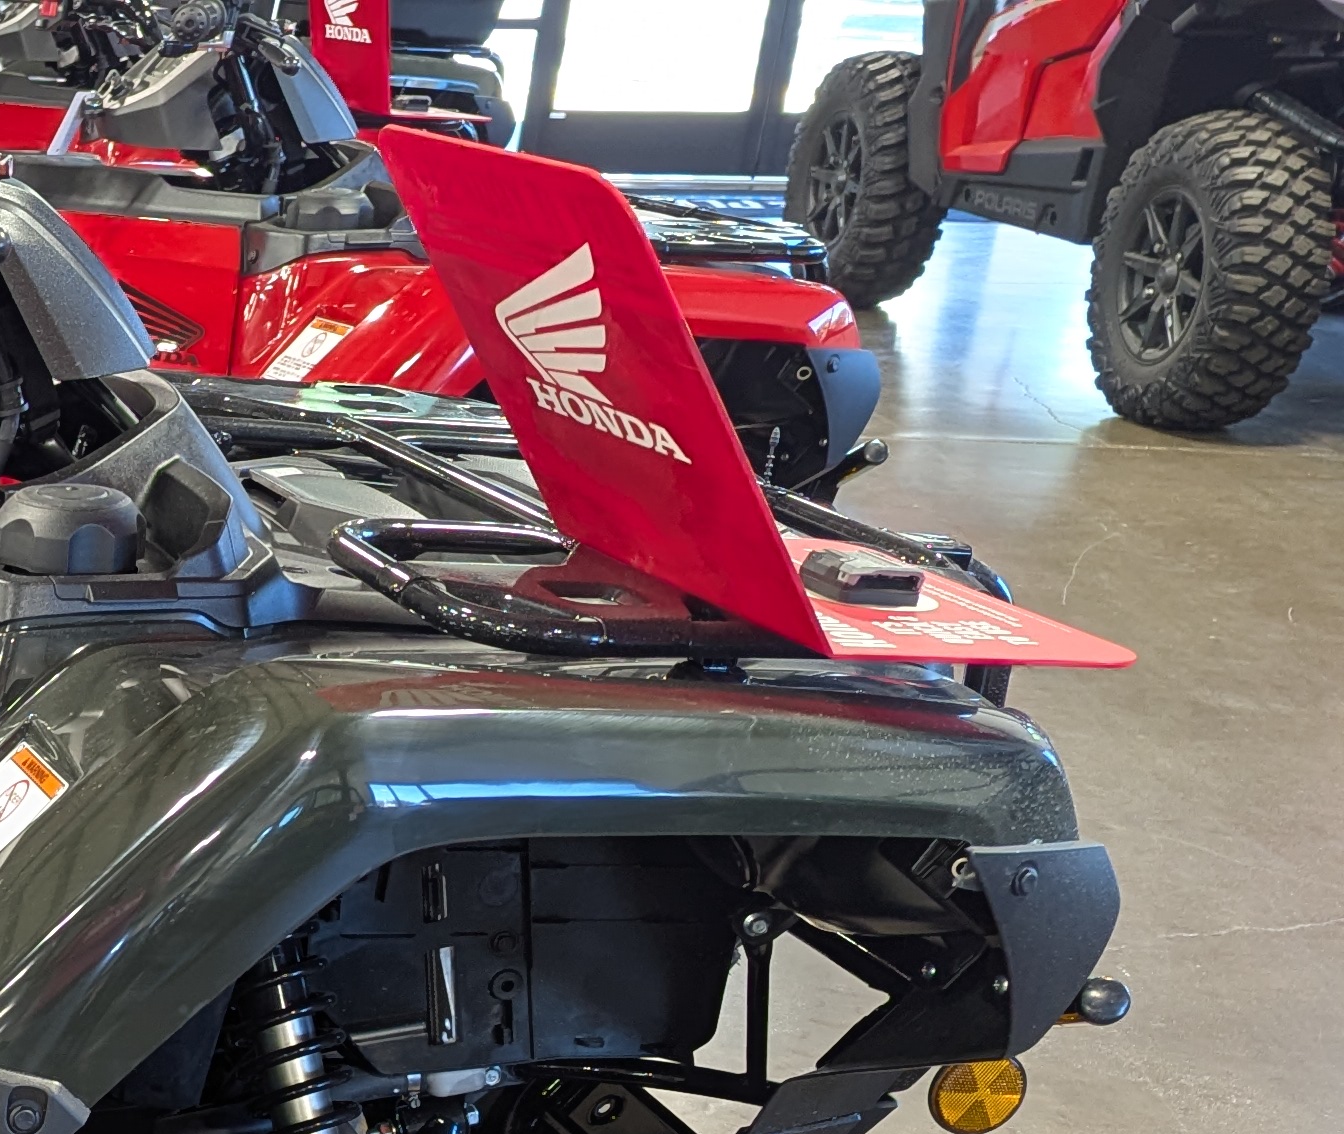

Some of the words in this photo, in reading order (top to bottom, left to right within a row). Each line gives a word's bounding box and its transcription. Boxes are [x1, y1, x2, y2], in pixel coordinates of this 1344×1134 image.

[324, 24, 372, 44] HONDA
[525, 377, 692, 465] HONDA
[25, 759, 50, 784] WARNING
